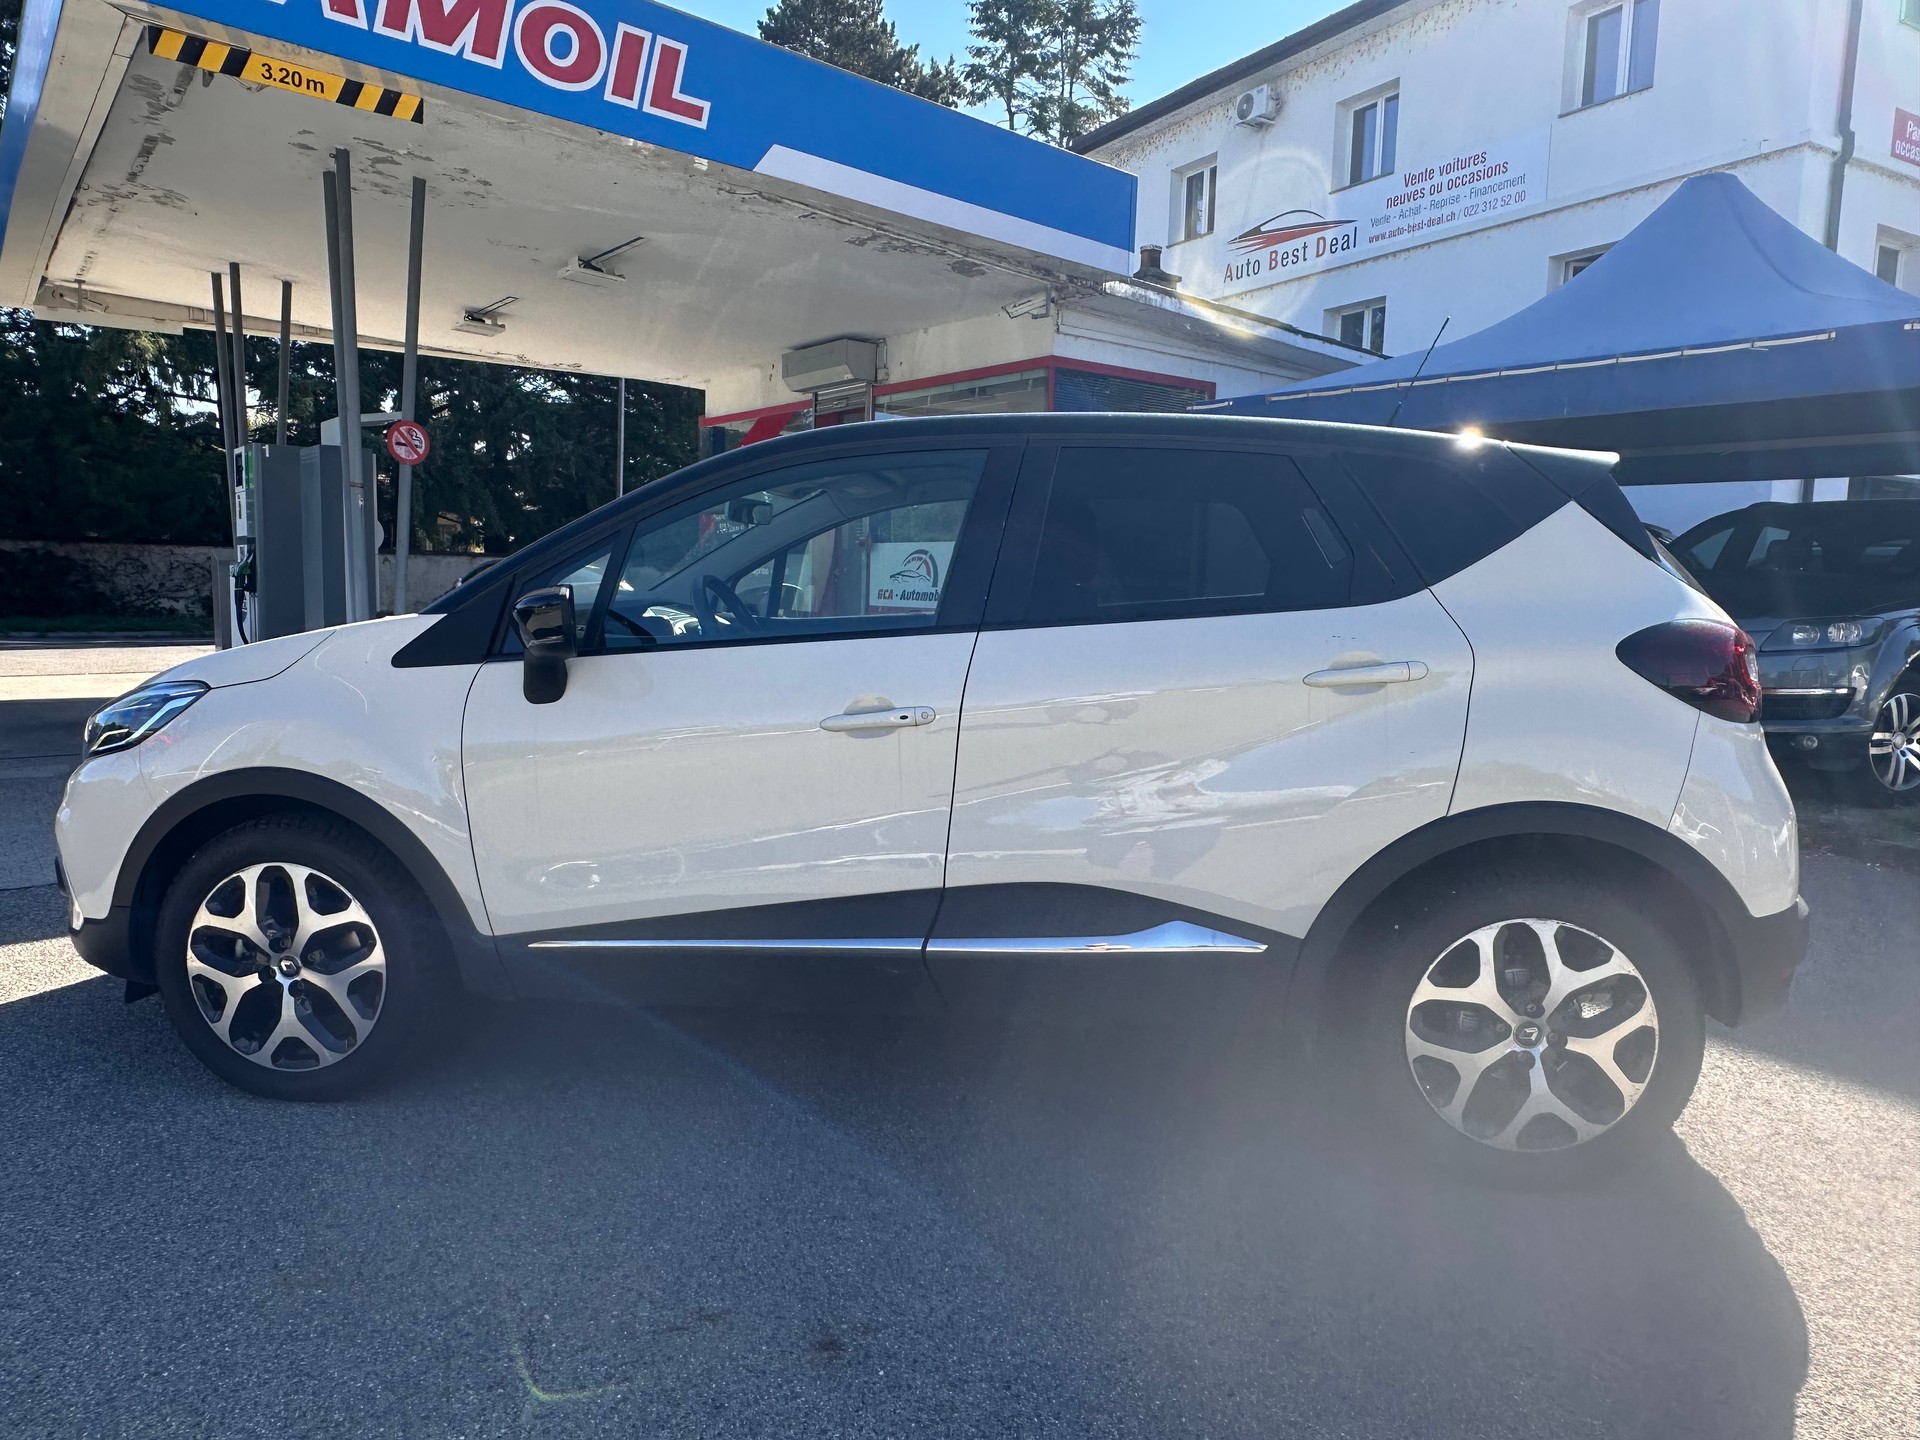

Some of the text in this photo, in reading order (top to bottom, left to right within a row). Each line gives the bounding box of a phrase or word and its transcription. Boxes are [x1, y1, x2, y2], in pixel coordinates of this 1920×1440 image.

[261, 63, 325, 94] 3.20 m
[268, 0, 711, 130] MOIL
[1386, 161, 1509, 209] neuves ou occasions
[1404, 151, 1488, 188] Vente voitures
[1368, 210, 1456, 244] www.auto-best-deal.ch
[1463, 203, 1480, 218] 022
[1481, 198, 1498, 213] 312
[1500, 194, 1512, 208] 52
[1514, 190, 1527, 204] 00
[1370, 214, 1391, 228] Vente
[1398, 205, 1421, 221] Achat
[1429, 194, 1461, 212] Reprise
[1469, 173, 1526, 200] Financement
[1223, 226, 1358, 283] Auto Best Deal
[877, 588, 894, 600] GCA
